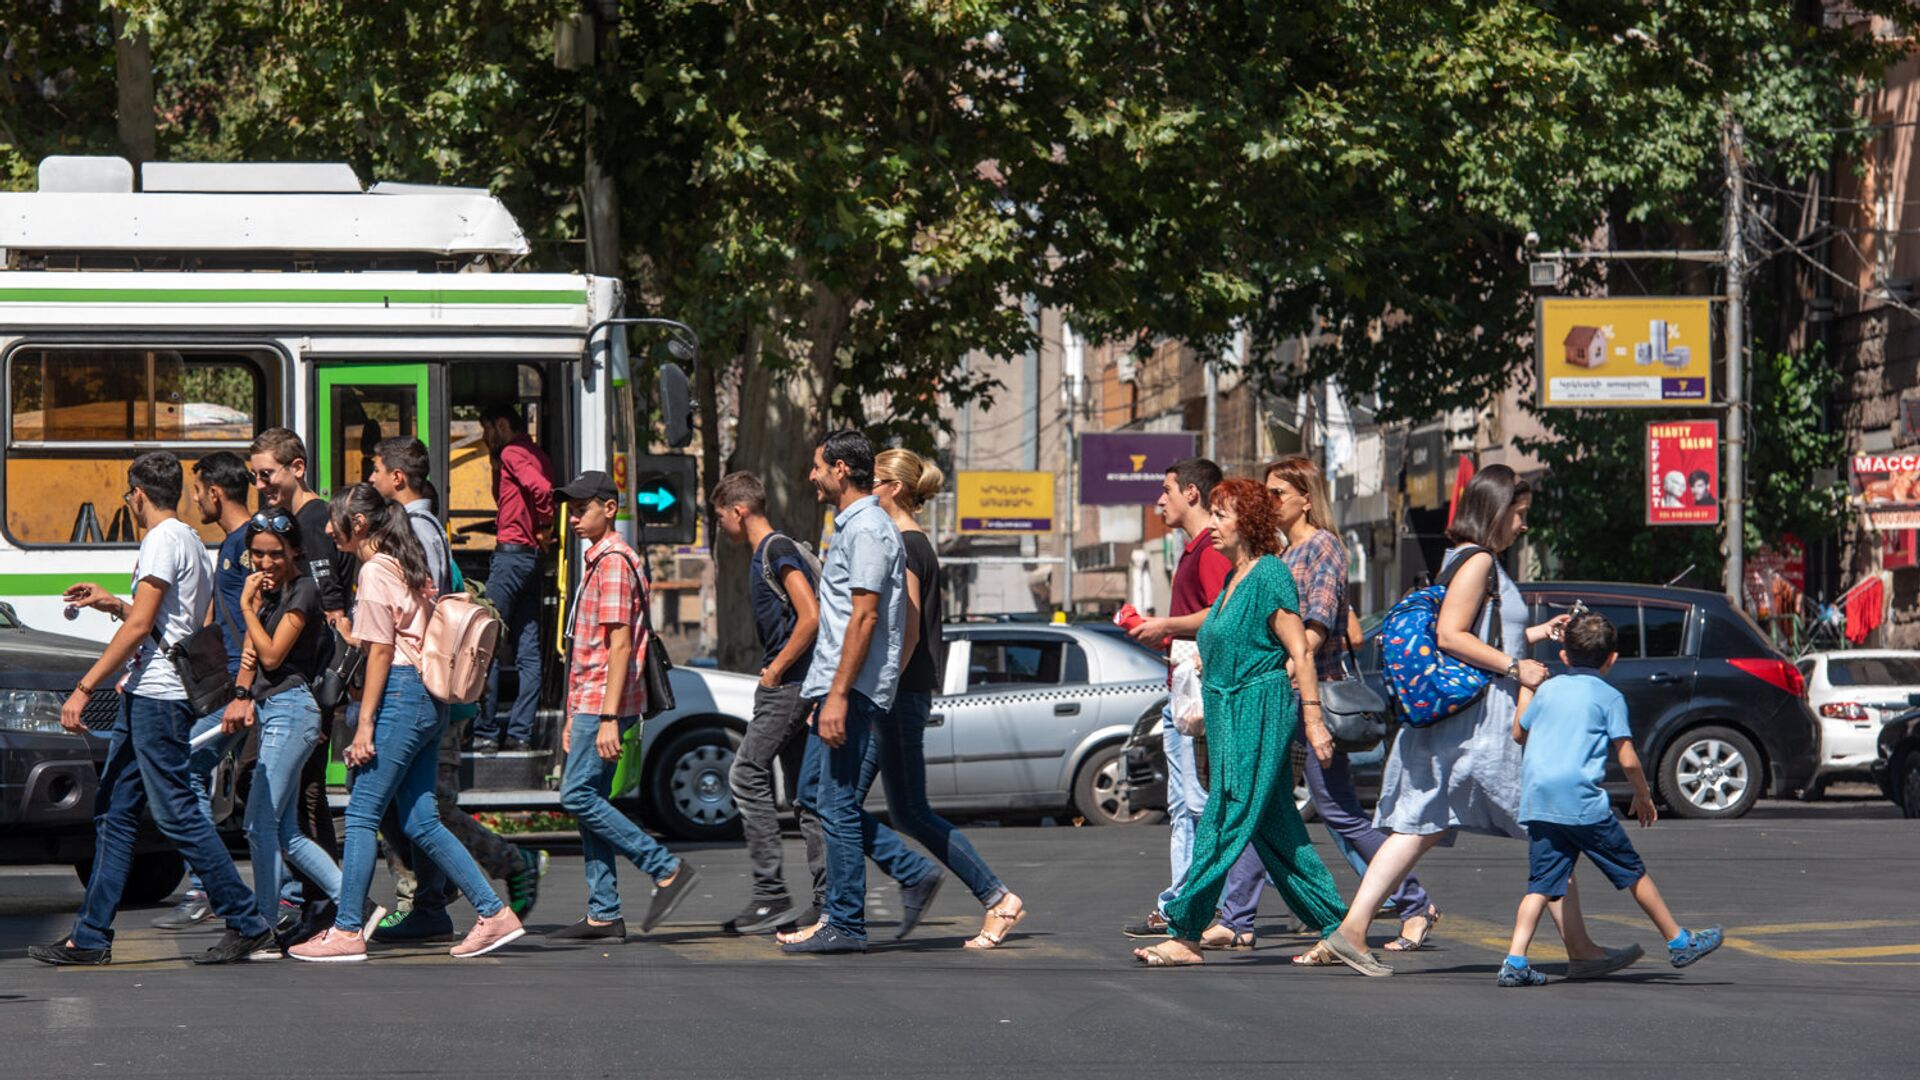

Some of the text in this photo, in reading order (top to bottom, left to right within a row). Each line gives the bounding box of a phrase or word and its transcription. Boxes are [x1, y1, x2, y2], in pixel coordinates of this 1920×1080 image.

[1652, 426, 1691, 438] BEAUTY
[1680, 438, 1712, 450] SALON
[1651, 439, 1661, 508] EFFEKT
